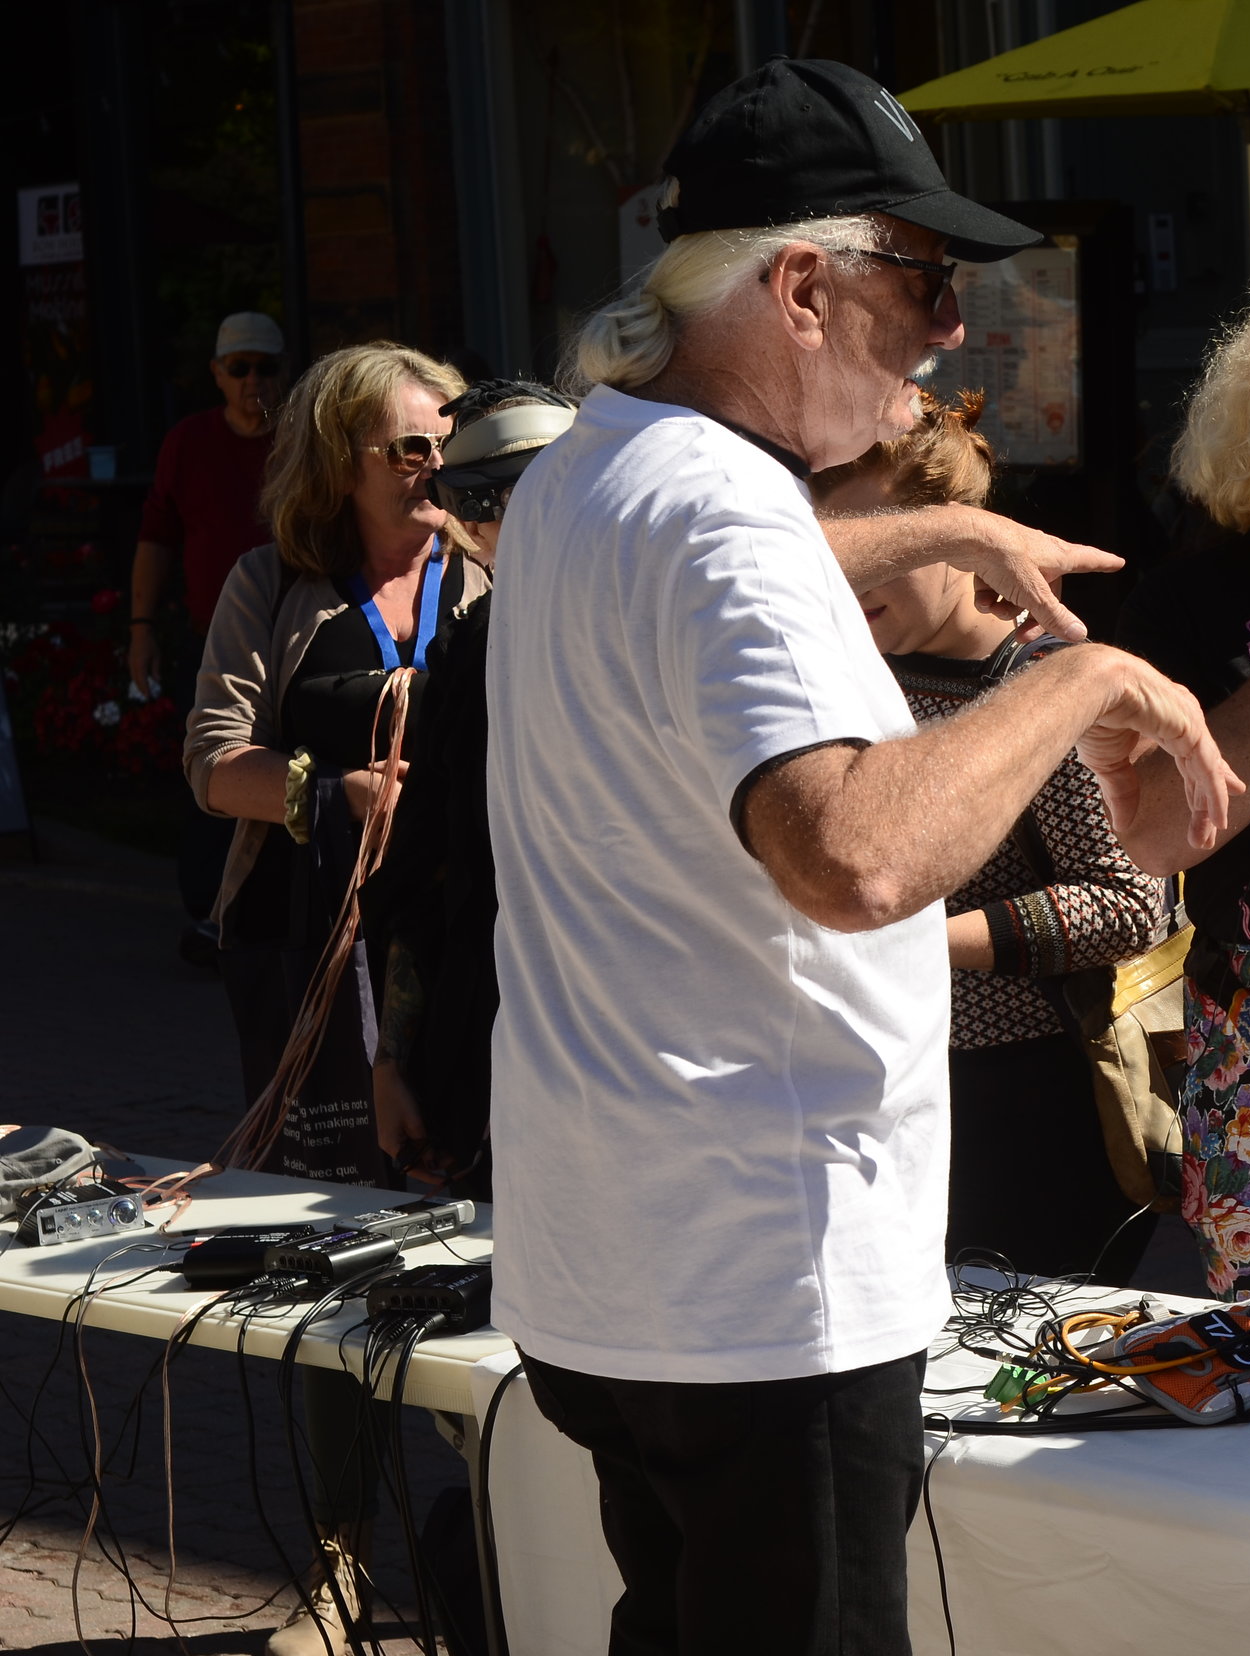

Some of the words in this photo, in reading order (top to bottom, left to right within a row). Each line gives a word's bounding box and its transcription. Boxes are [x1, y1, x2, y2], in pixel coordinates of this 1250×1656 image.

[309, 1102, 338, 1116] what
[341, 1100, 349, 1111] is
[351, 1099, 363, 1110] not
[314, 1116, 354, 1130] making
[356, 1114, 369, 1126] and
[309, 1168, 332, 1179] avec
[336, 1163, 359, 1178] quoi,
